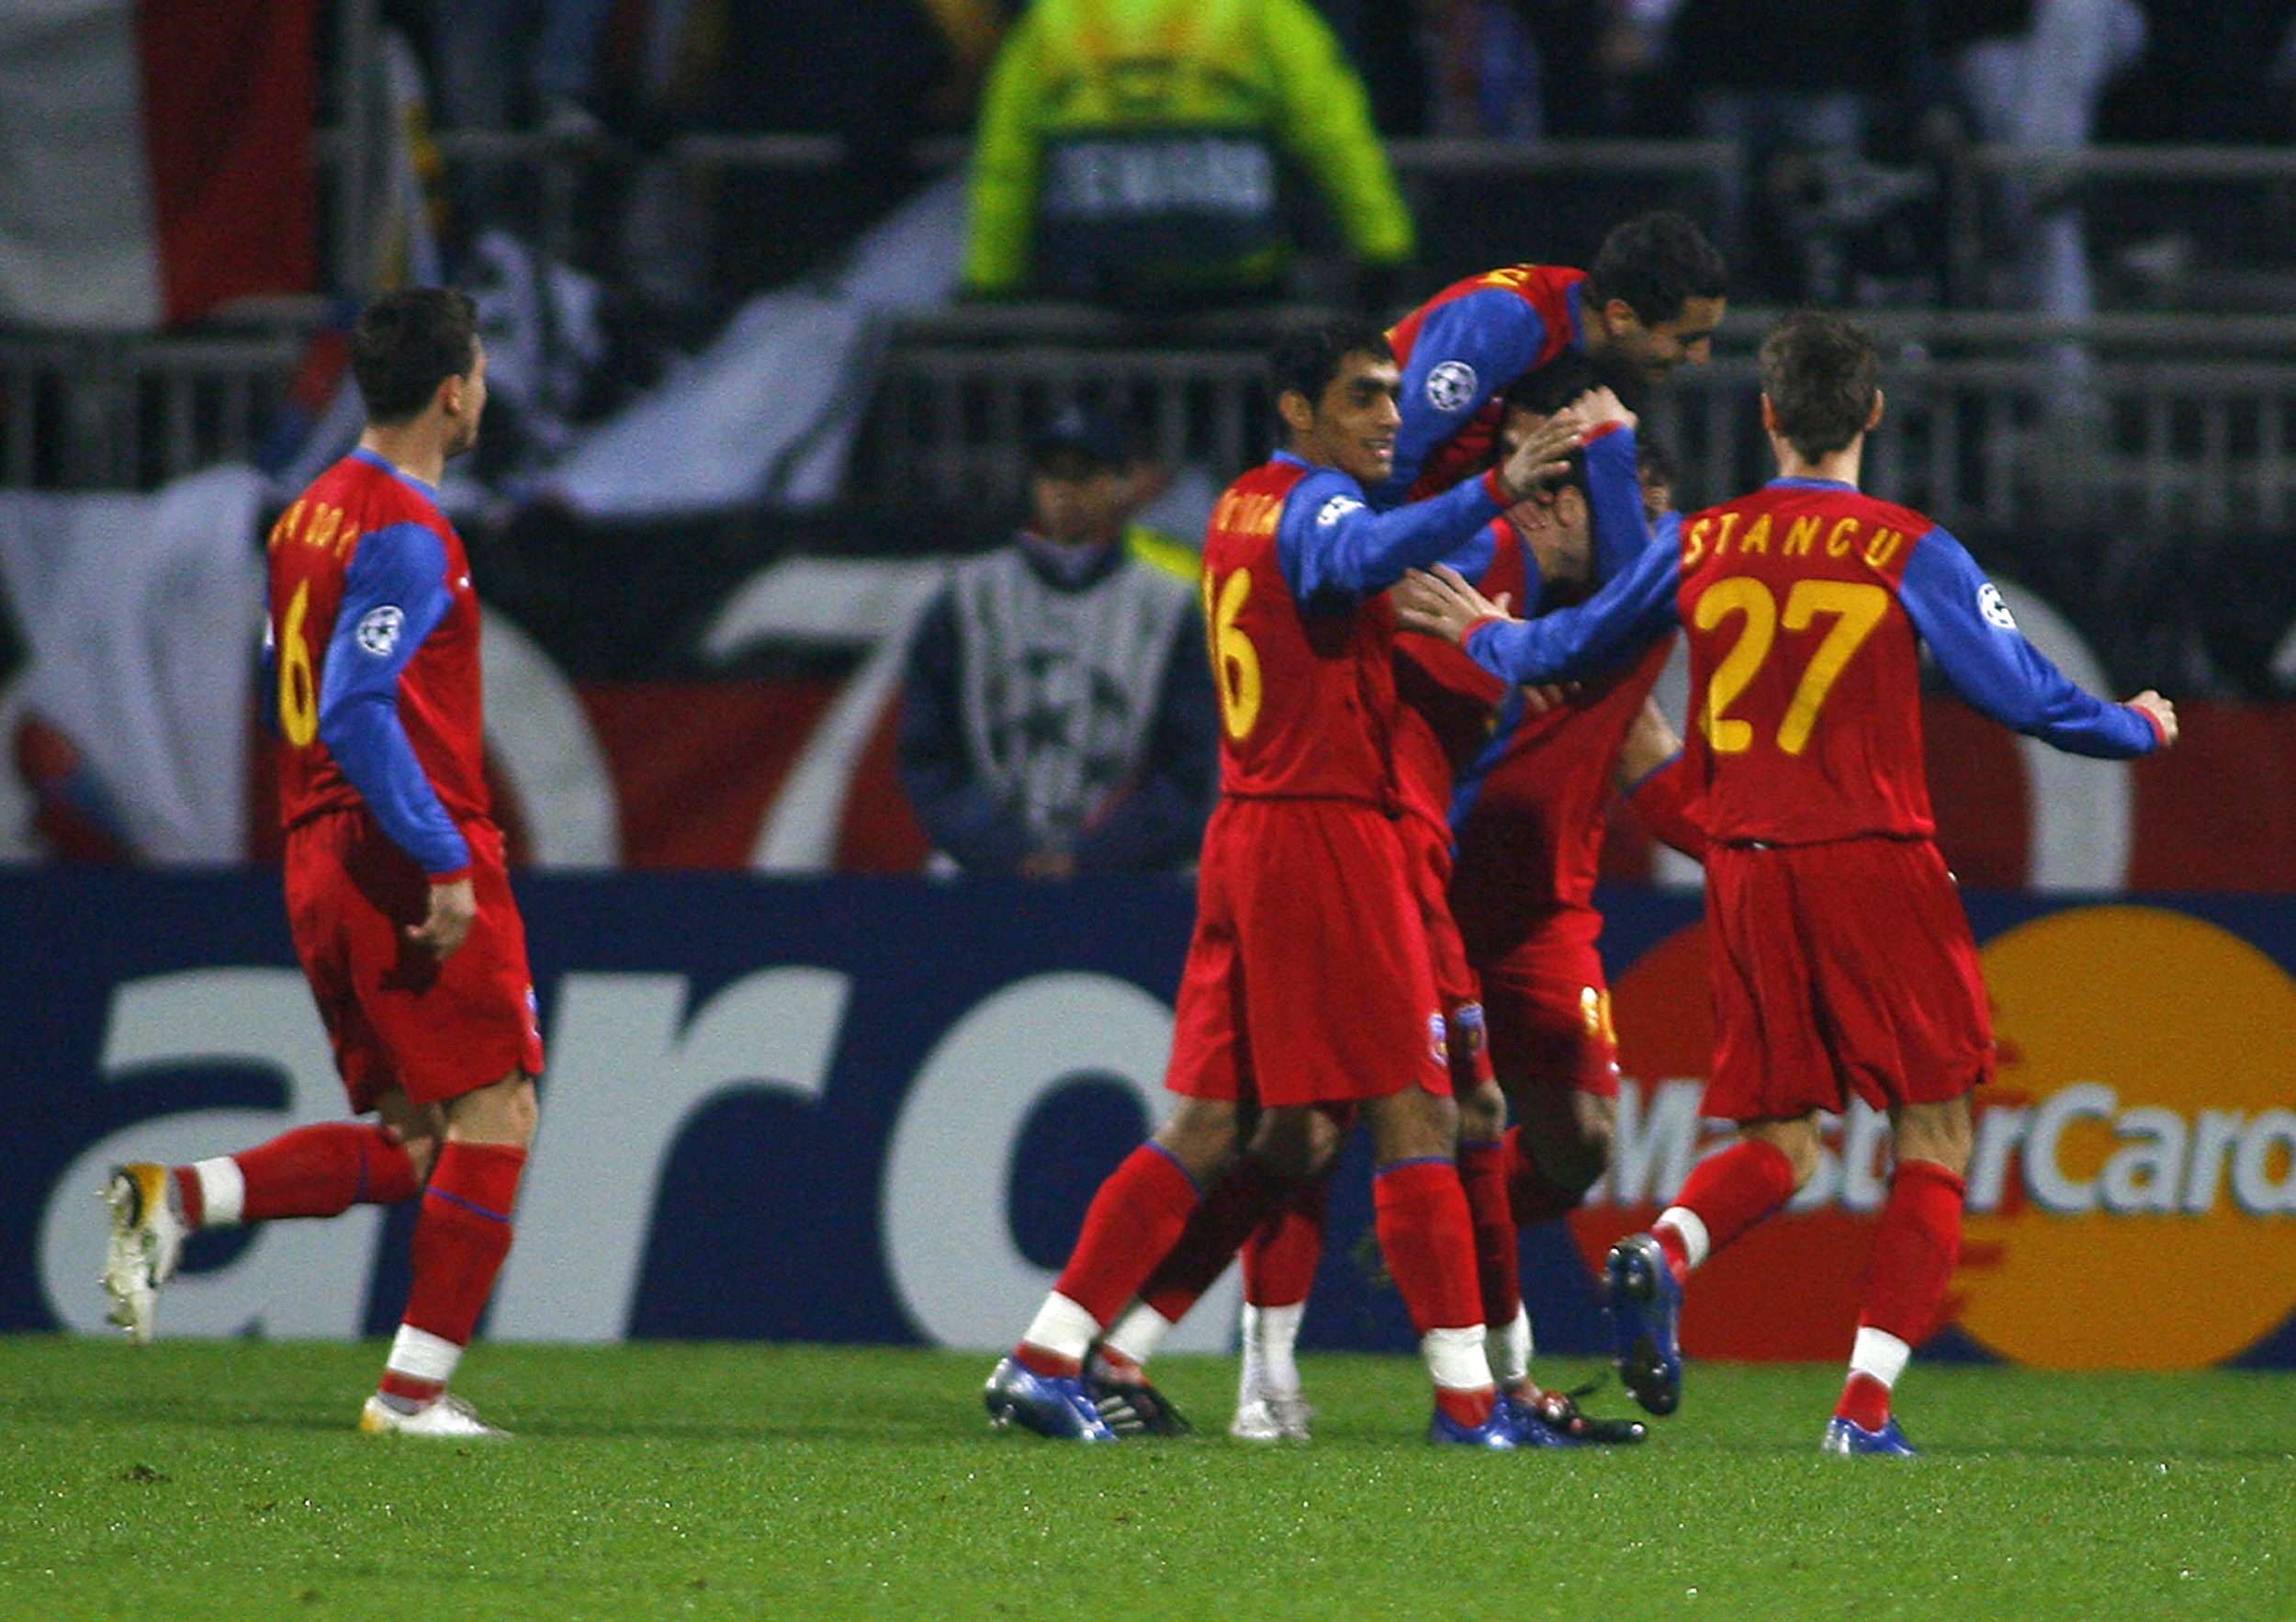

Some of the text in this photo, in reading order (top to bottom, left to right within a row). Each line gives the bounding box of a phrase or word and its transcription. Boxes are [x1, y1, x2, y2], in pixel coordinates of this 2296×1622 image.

[1682, 512, 1905, 568] STANCU
[280, 578, 318, 747] 6
[1694, 576, 1889, 756] 27
